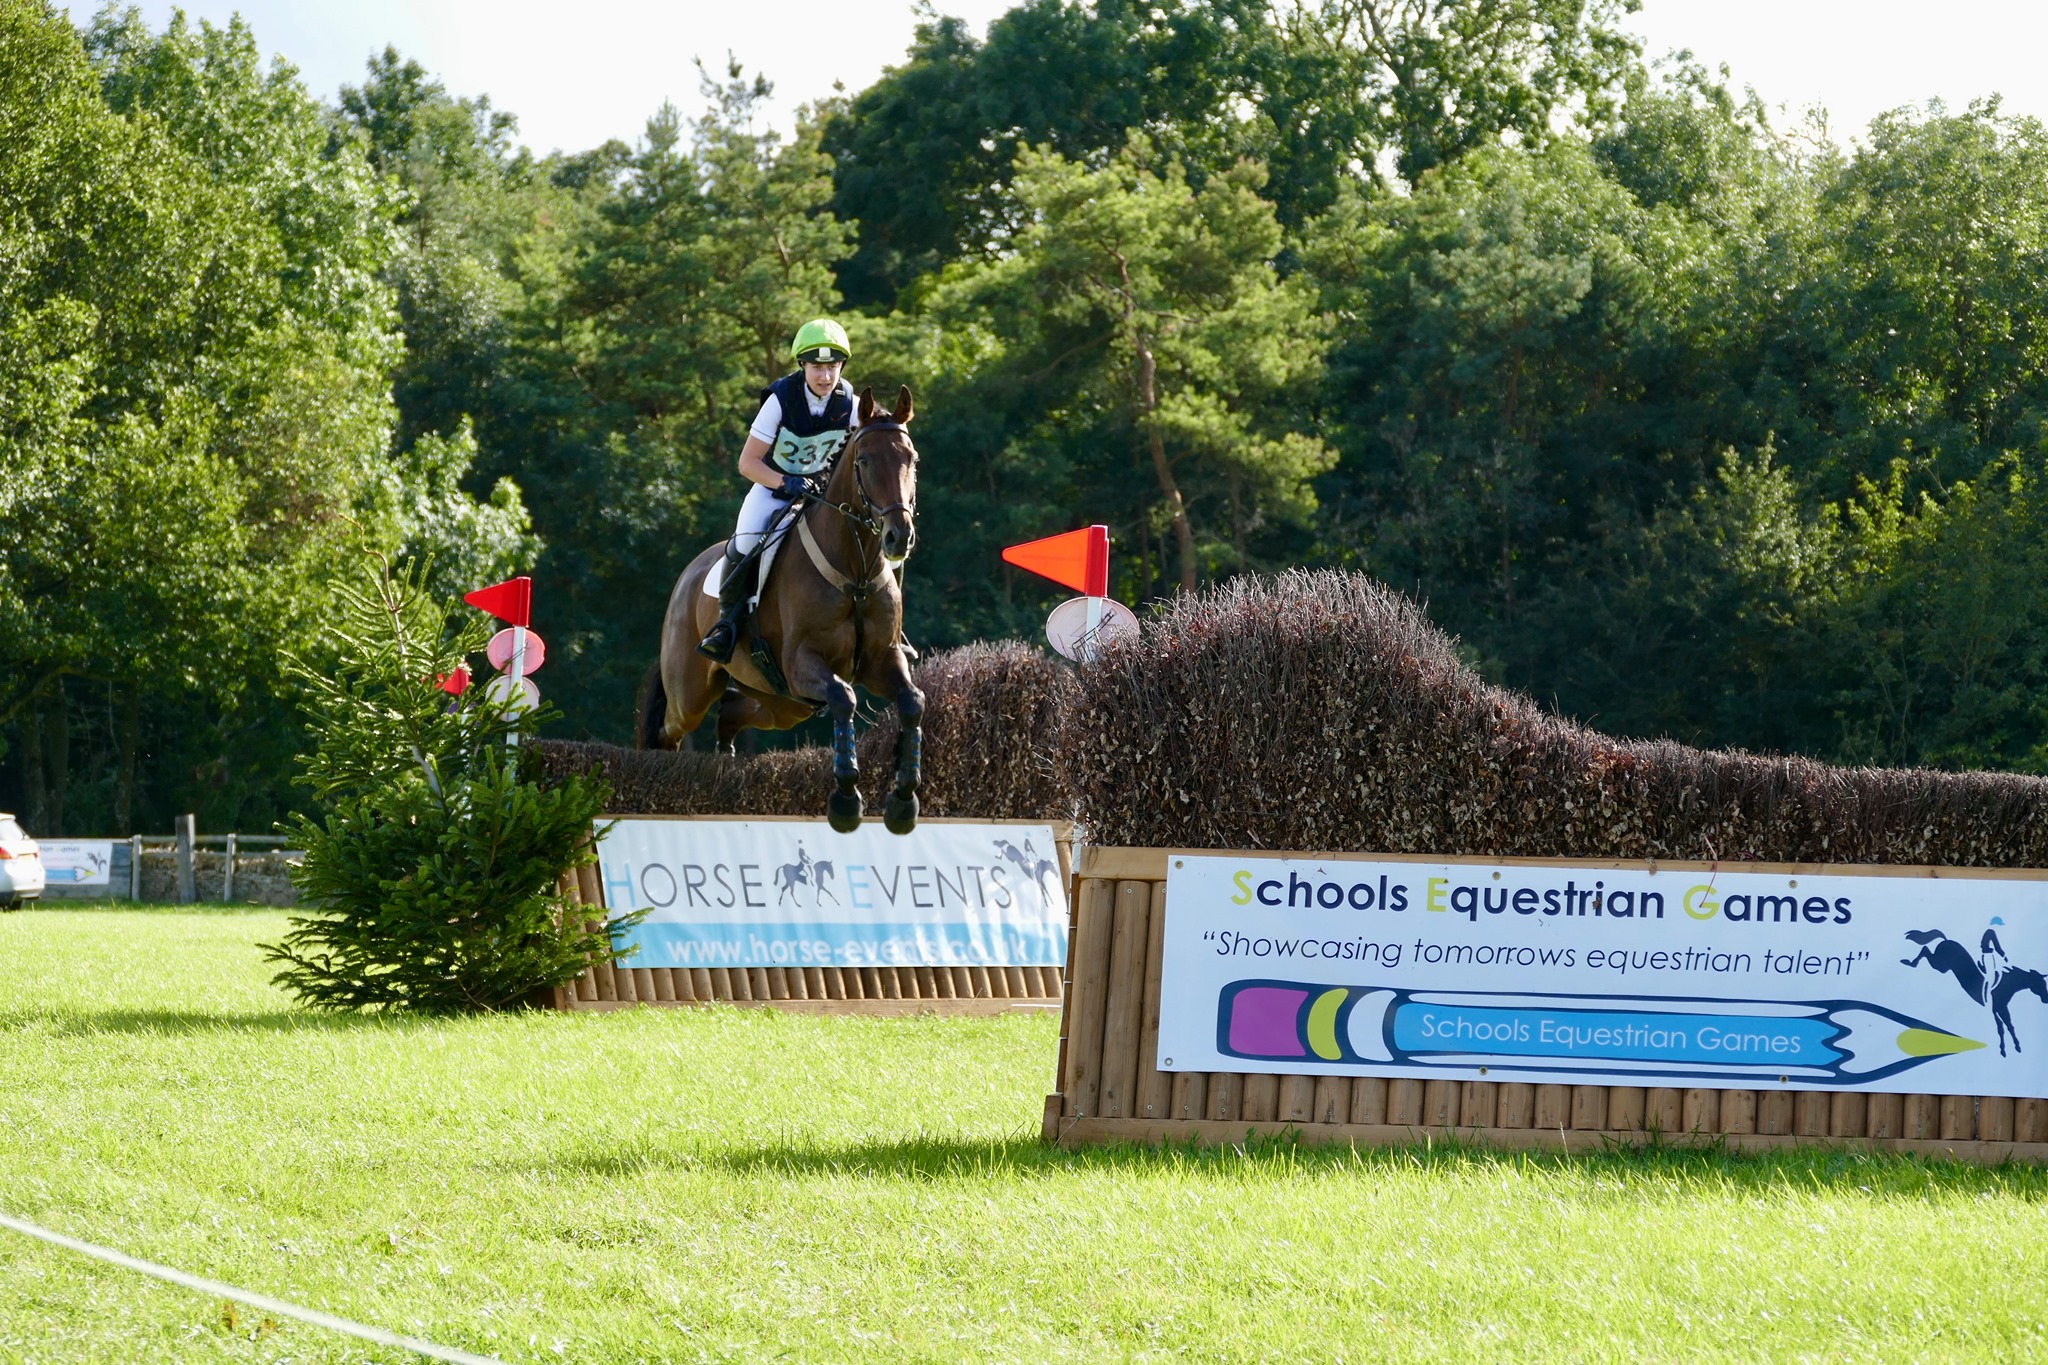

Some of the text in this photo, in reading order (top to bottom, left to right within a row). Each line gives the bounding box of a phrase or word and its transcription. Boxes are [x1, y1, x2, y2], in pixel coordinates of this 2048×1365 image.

[780, 439, 837, 465] 237
[603, 862, 1012, 909] HORSE EVENTS
[1231, 870, 1853, 925] Schools Equestrian Games
[666, 932, 1028, 964] www.horse-evens.co.uk
[1203, 931, 1870, 976] “Showcasing tomorrows equestrian talent”
[1421, 1014, 1801, 1054] Schools Equestrian Games
